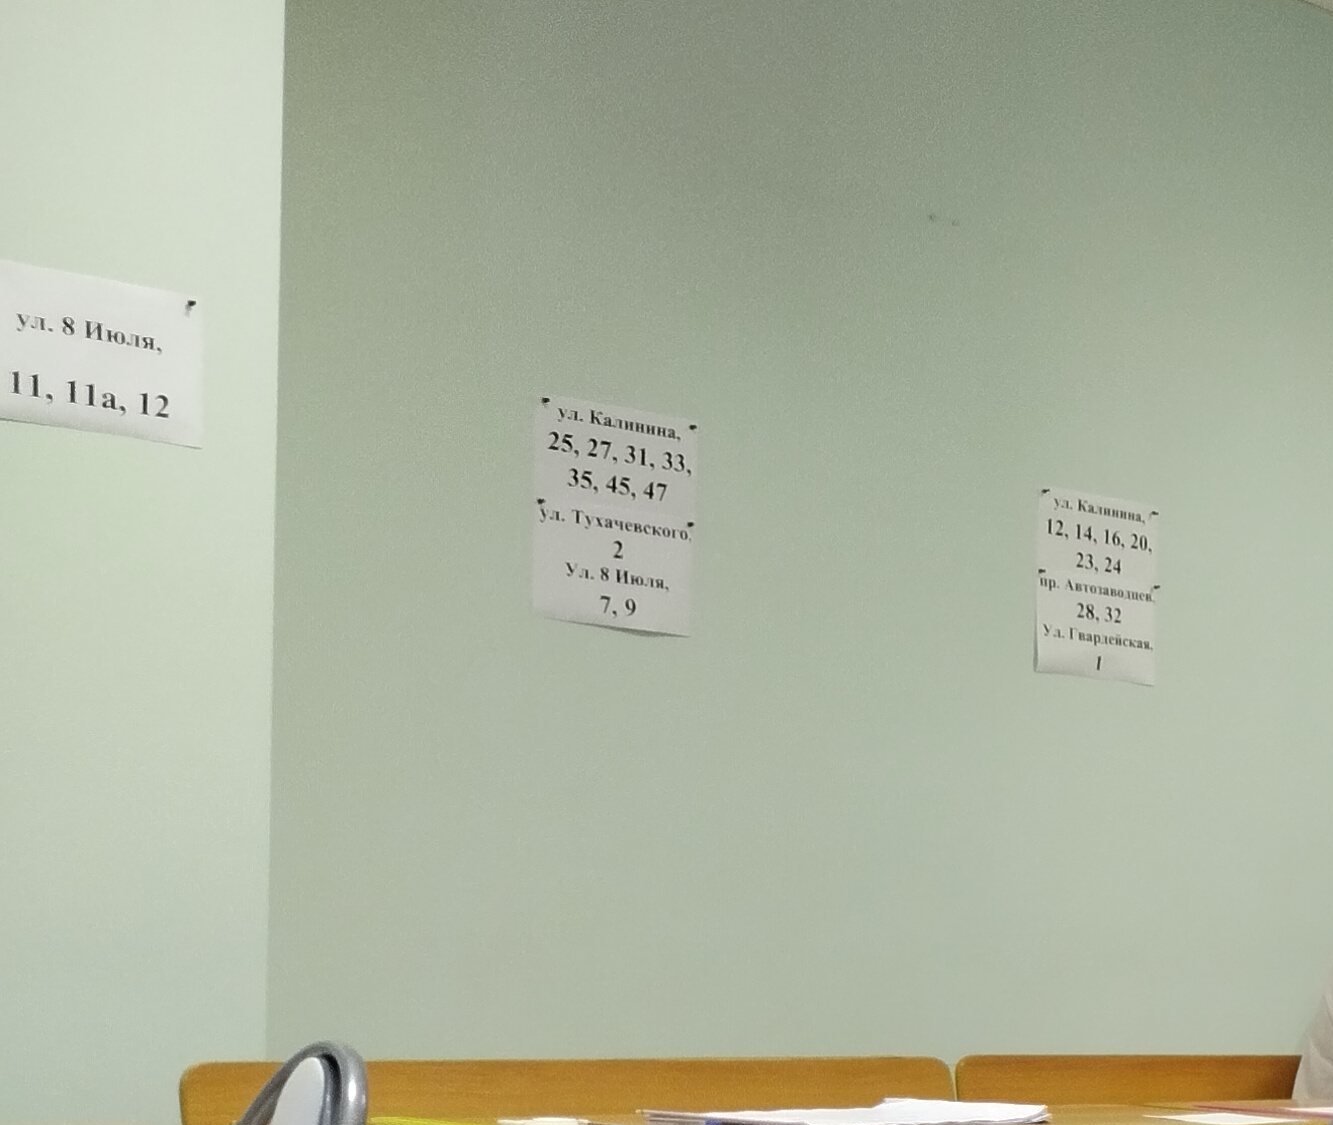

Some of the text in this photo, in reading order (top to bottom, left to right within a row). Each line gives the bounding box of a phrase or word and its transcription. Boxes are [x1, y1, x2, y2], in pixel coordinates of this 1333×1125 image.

[16, 313, 162, 354] ул. 8 Июля,
[10, 370, 170, 418] 11, 11а, 12
[557, 407, 681, 441] ул. Калинина,
[547, 431, 692, 476] 25, 27, 31, 33,
[566, 468, 668, 501] 35, 45, 47
[539, 507, 692, 542] ул. Тухачевского,
[1054, 498, 1146, 524] ул. Калинина,
[613, 540, 624, 559] 2
[1047, 518, 1152, 553] 12, 14, 16, 20,
[565, 562, 670, 592] Ул. 8 Июля,
[1076, 552, 1122, 574] 23, 24
[1040, 576, 1060, 590] пр.
[599, 595, 637, 618] 7, 9
[1077, 602, 1122, 623] 28, 32
[1043, 624, 1065, 639] Ул.
[1096, 656, 1101, 670] 1
